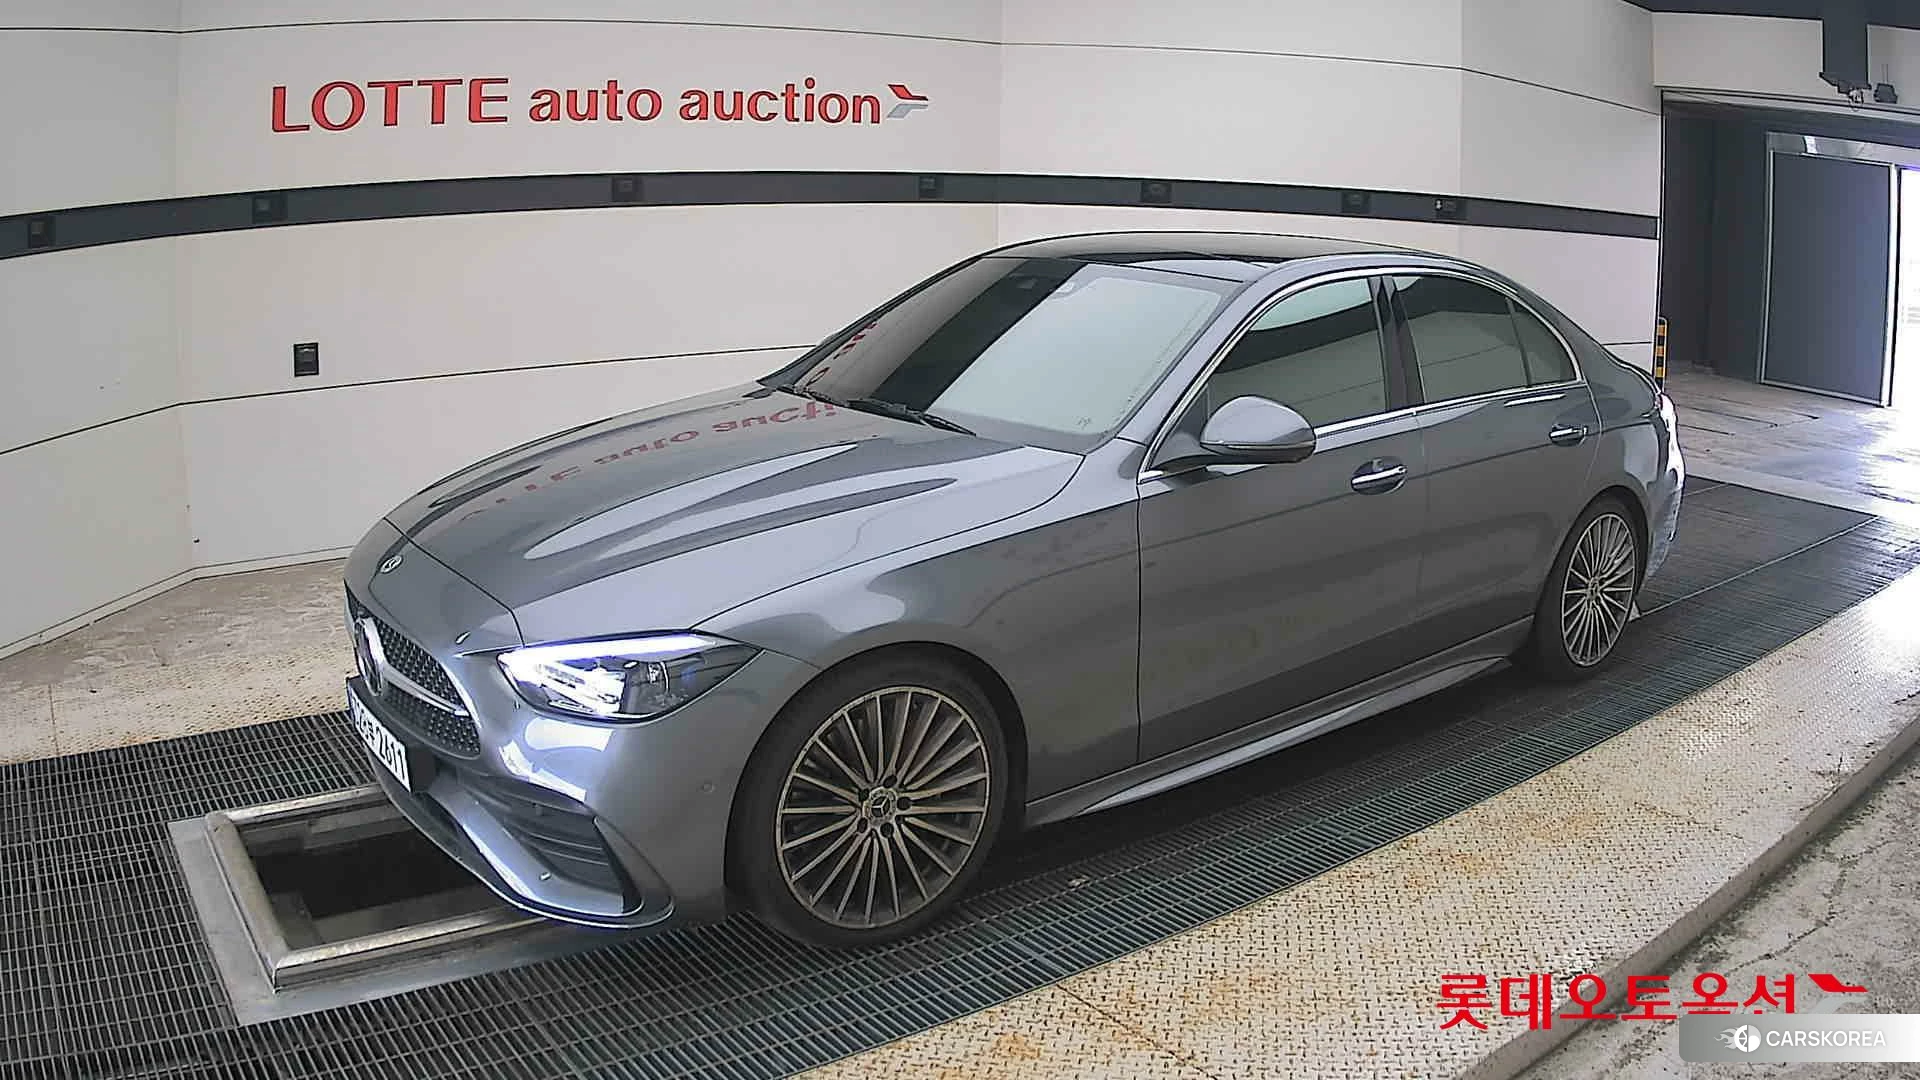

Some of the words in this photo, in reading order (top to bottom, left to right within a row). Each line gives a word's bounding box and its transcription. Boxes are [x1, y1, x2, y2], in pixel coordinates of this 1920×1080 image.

[271, 78, 509, 133] LOTTE
[529, 80, 663, 123] auto
[678, 78, 881, 124] auction
